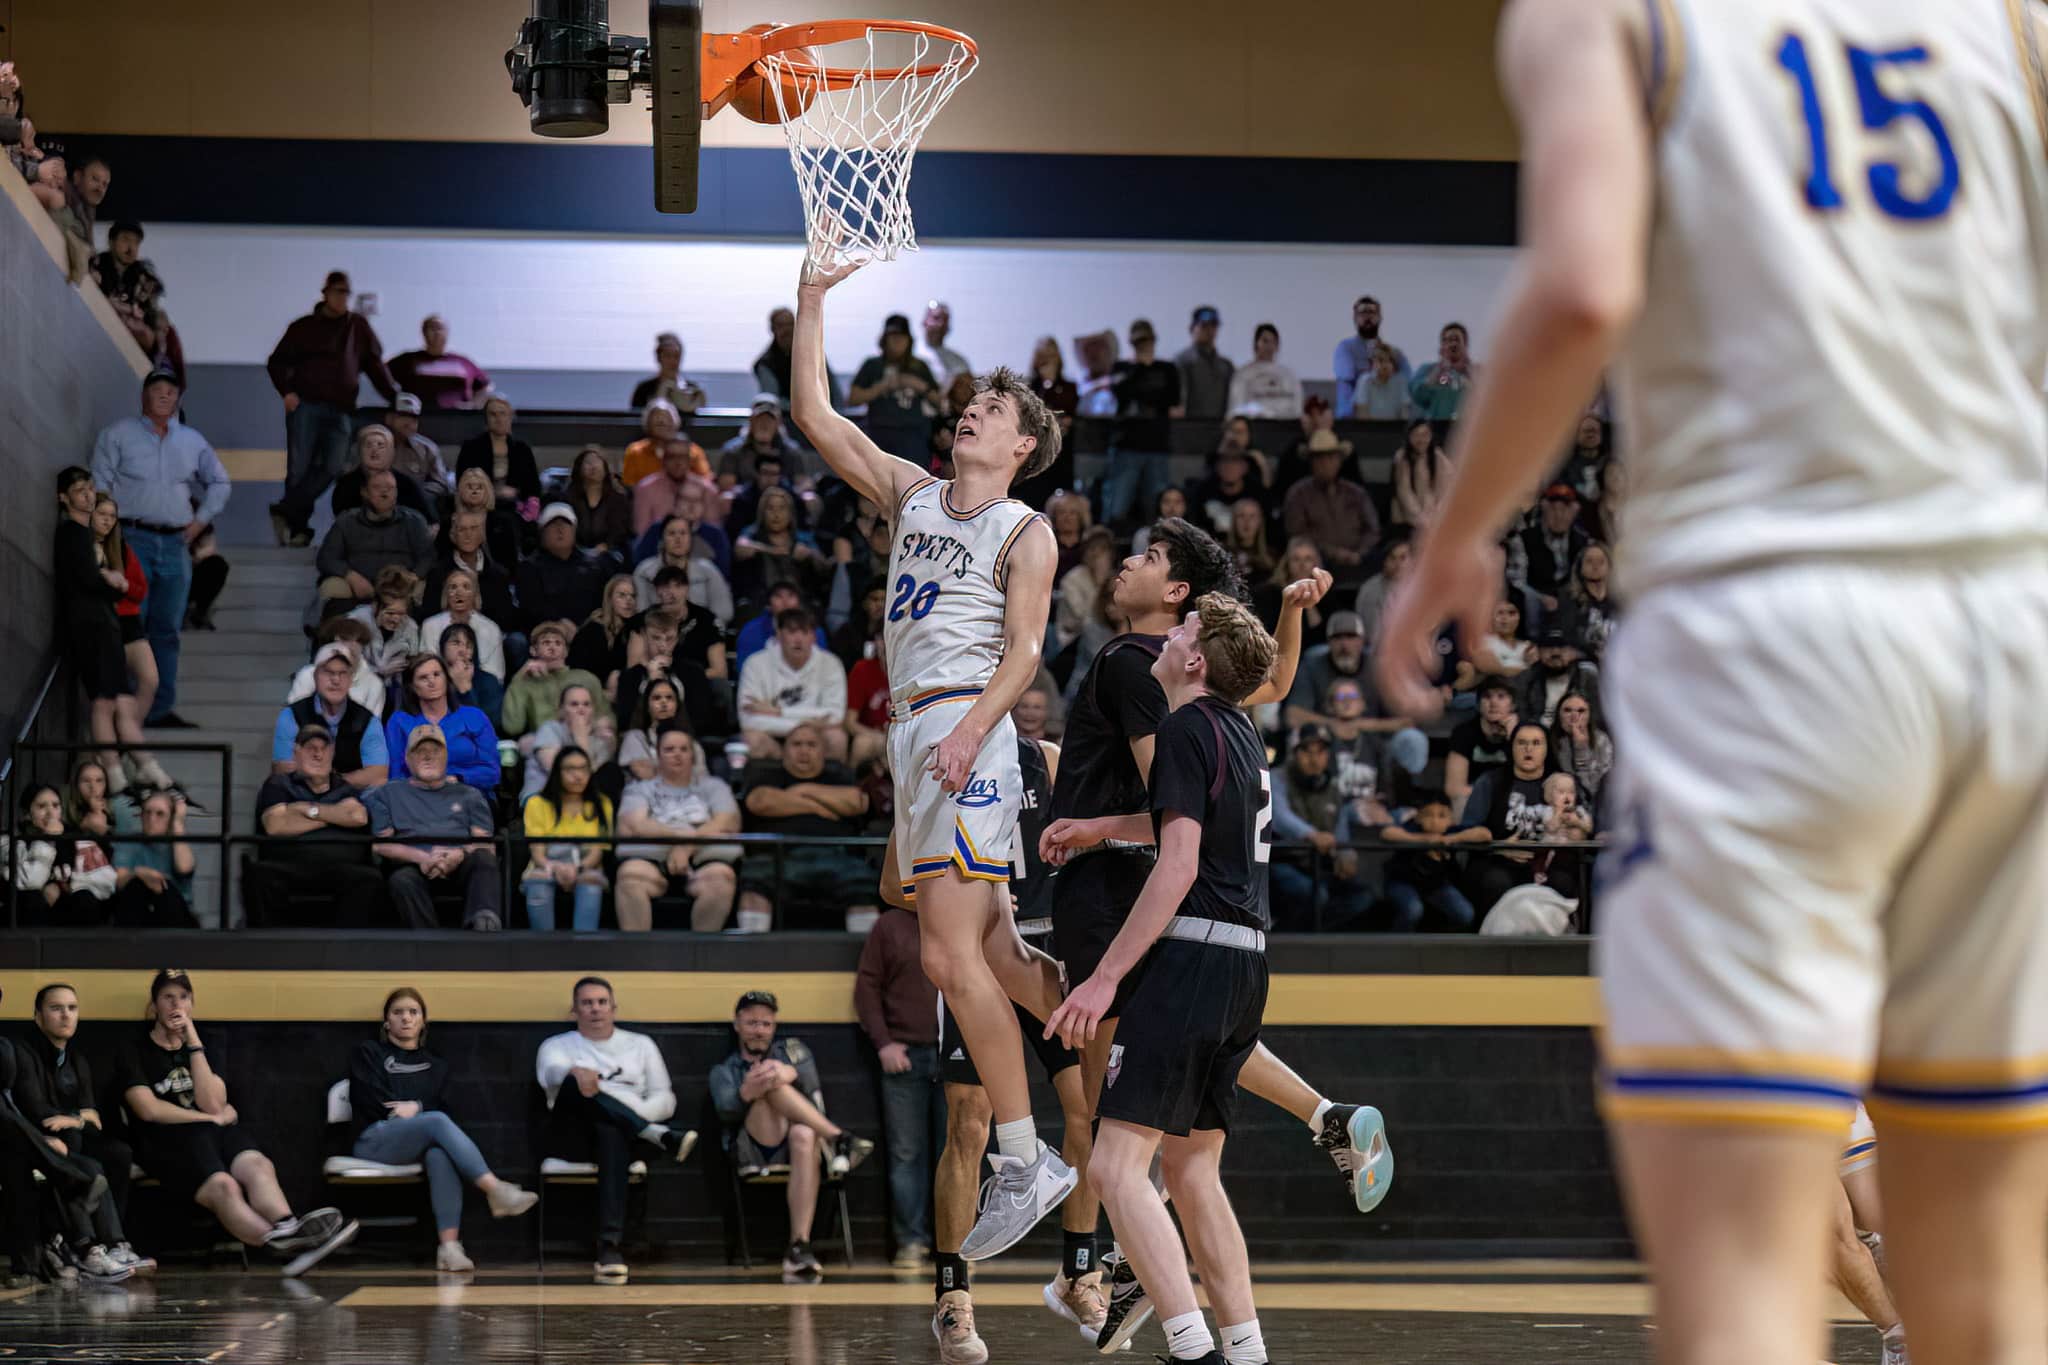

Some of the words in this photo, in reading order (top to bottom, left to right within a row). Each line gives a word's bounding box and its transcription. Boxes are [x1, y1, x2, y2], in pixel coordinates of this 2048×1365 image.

[1777, 32, 1960, 220] 15
[888, 573, 940, 622] 20
[1254, 768, 1273, 864] 2
